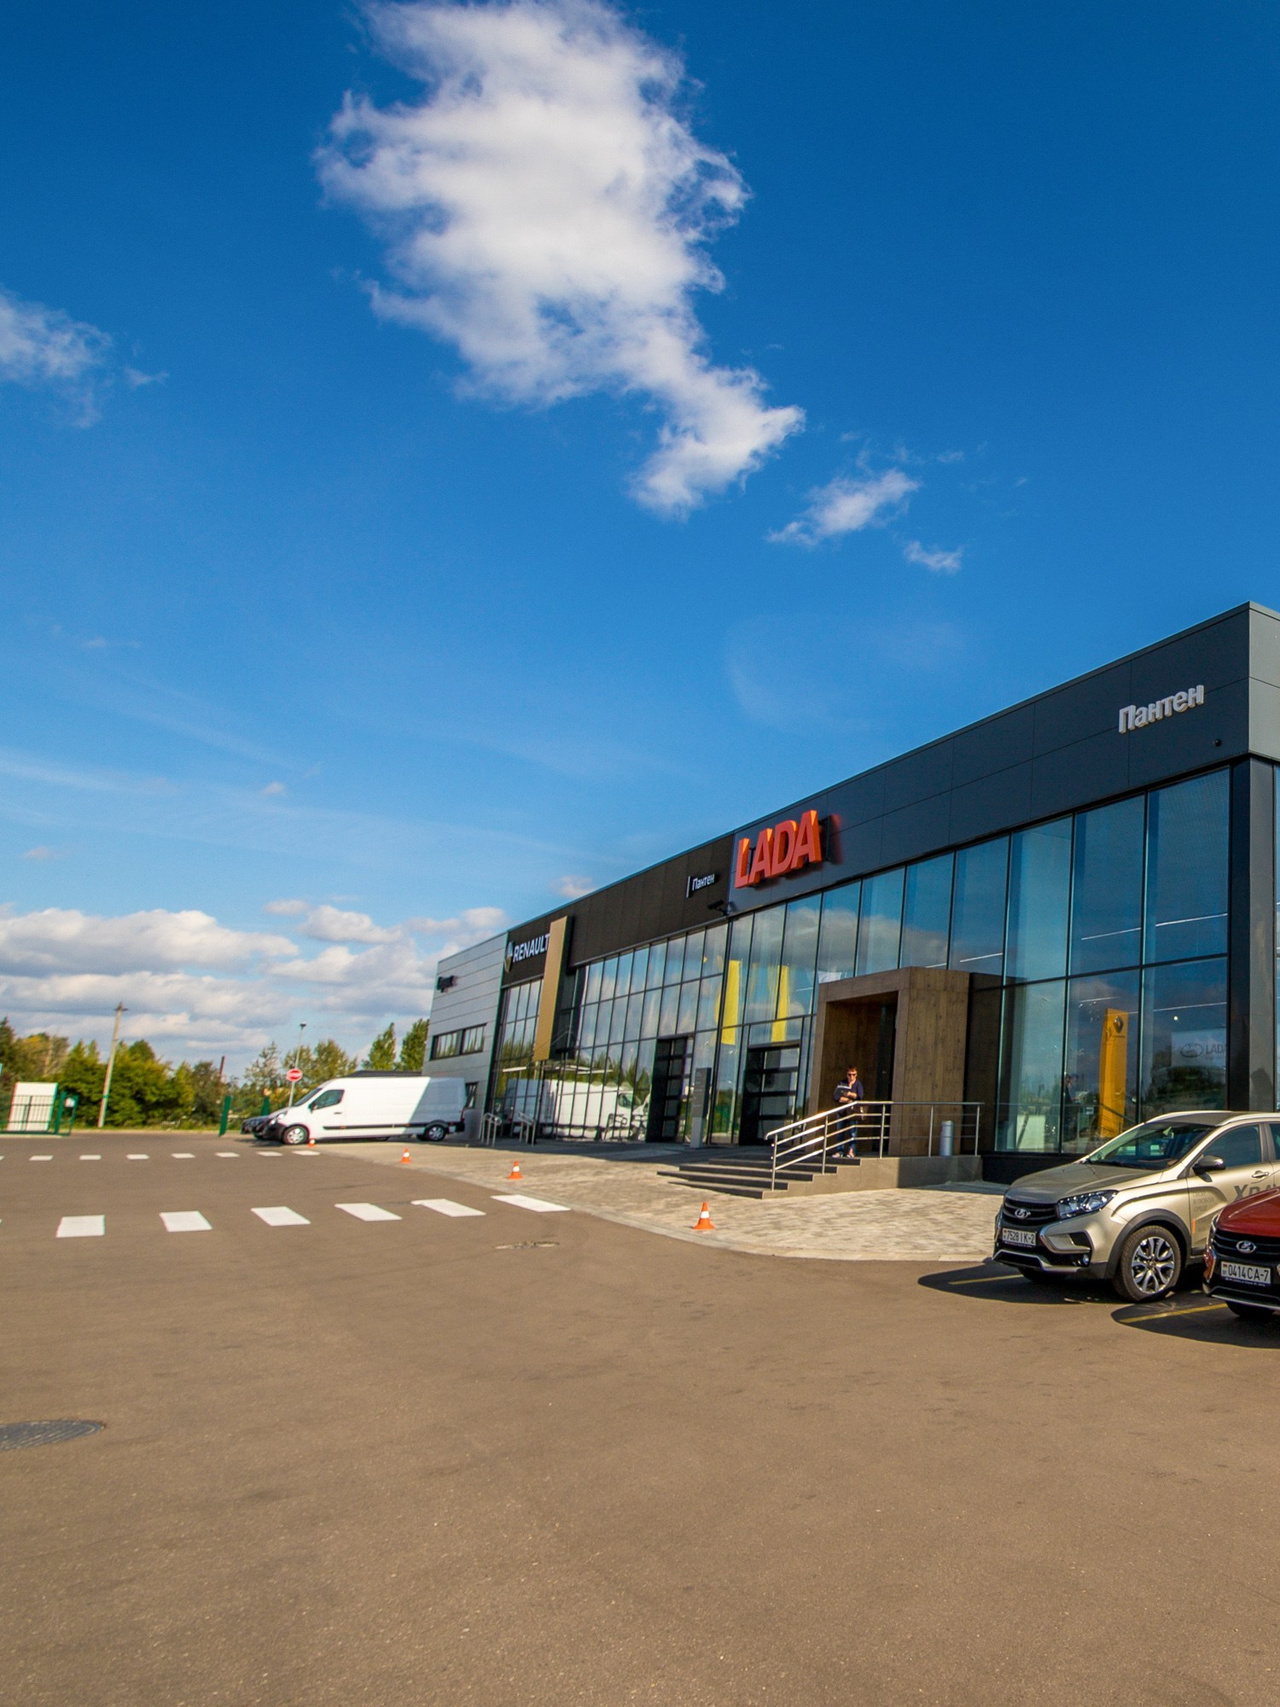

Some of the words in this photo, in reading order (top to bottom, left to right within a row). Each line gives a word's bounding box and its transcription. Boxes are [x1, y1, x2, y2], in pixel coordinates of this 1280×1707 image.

[1118, 685, 1205, 734] Пантен
[734, 809, 822, 889] LADA
[512, 933, 550, 963] RENAULT
[1205, 1043, 1225, 1055] LAD
